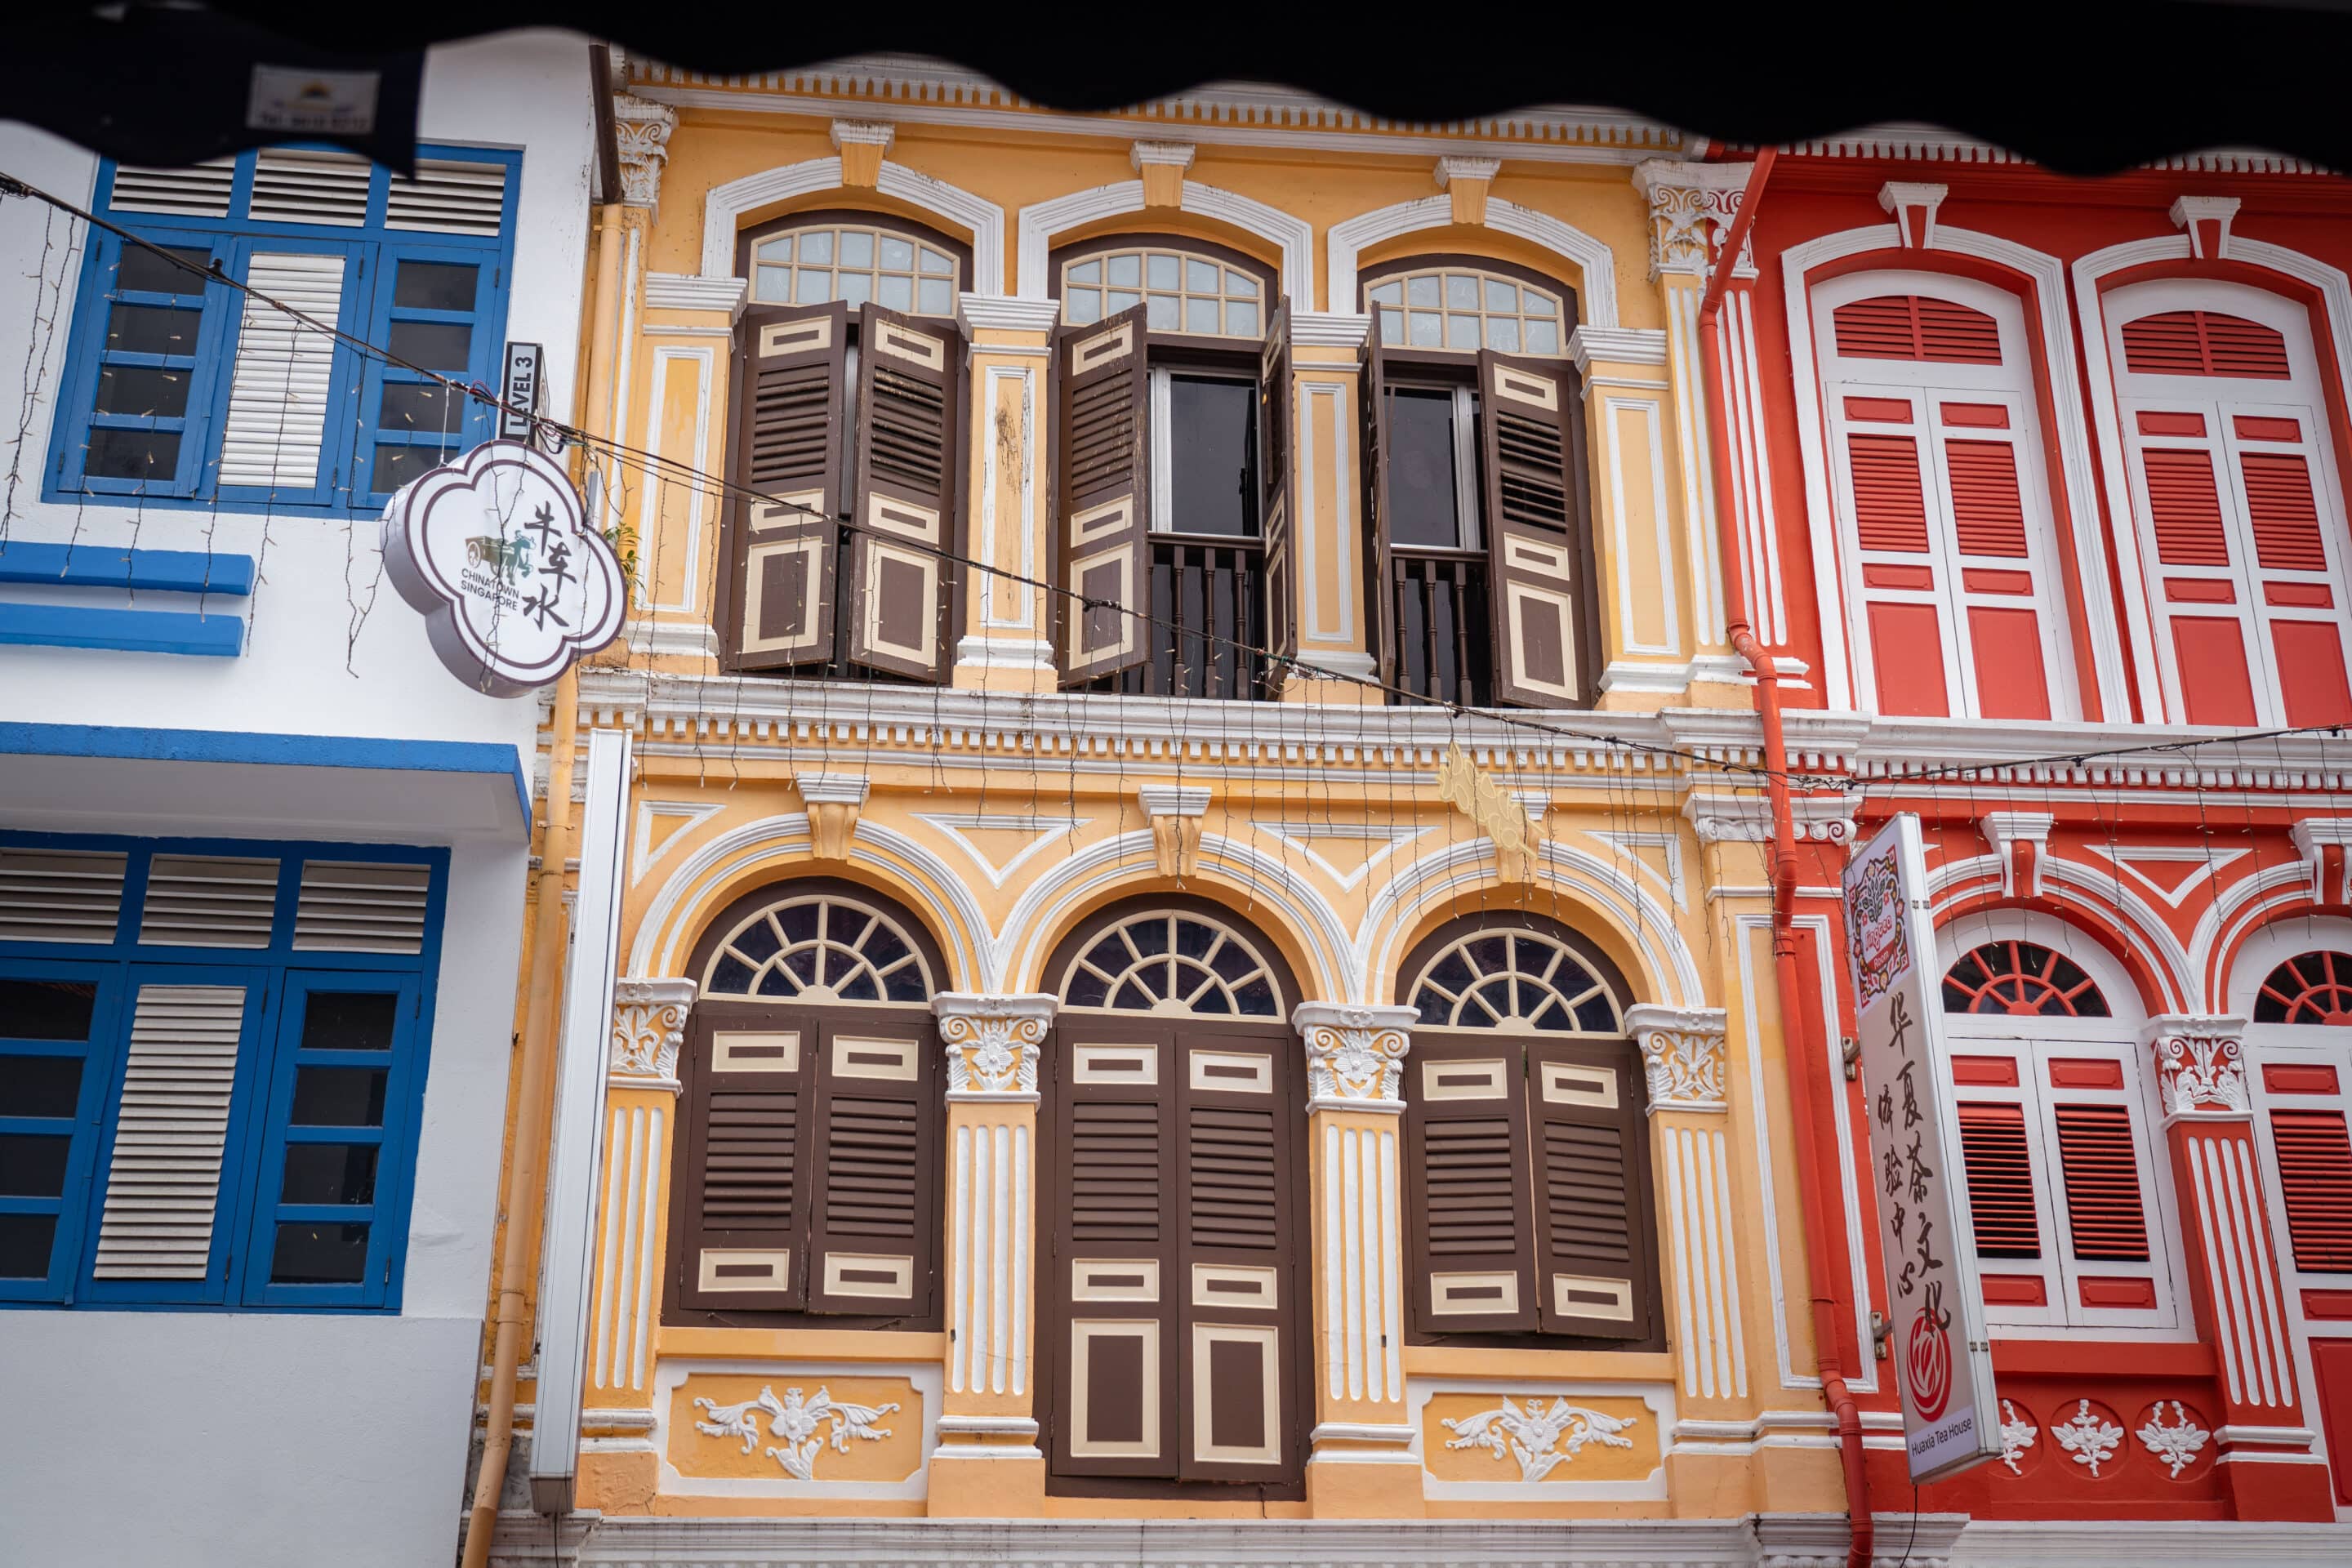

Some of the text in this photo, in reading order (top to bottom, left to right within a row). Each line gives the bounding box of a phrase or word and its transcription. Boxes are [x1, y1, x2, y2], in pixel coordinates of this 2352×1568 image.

[514, 356, 532, 368] 3
[522, 500, 577, 632] 牛车水
[461, 568, 519, 599] CHINATOWN
[461, 580, 519, 612] SINGAPORE
[1873, 950, 1889, 970] Room
[1888, 991, 1951, 1338] 华夏茶文化
[1911, 1418, 1972, 1458] Huaxia Tea House
